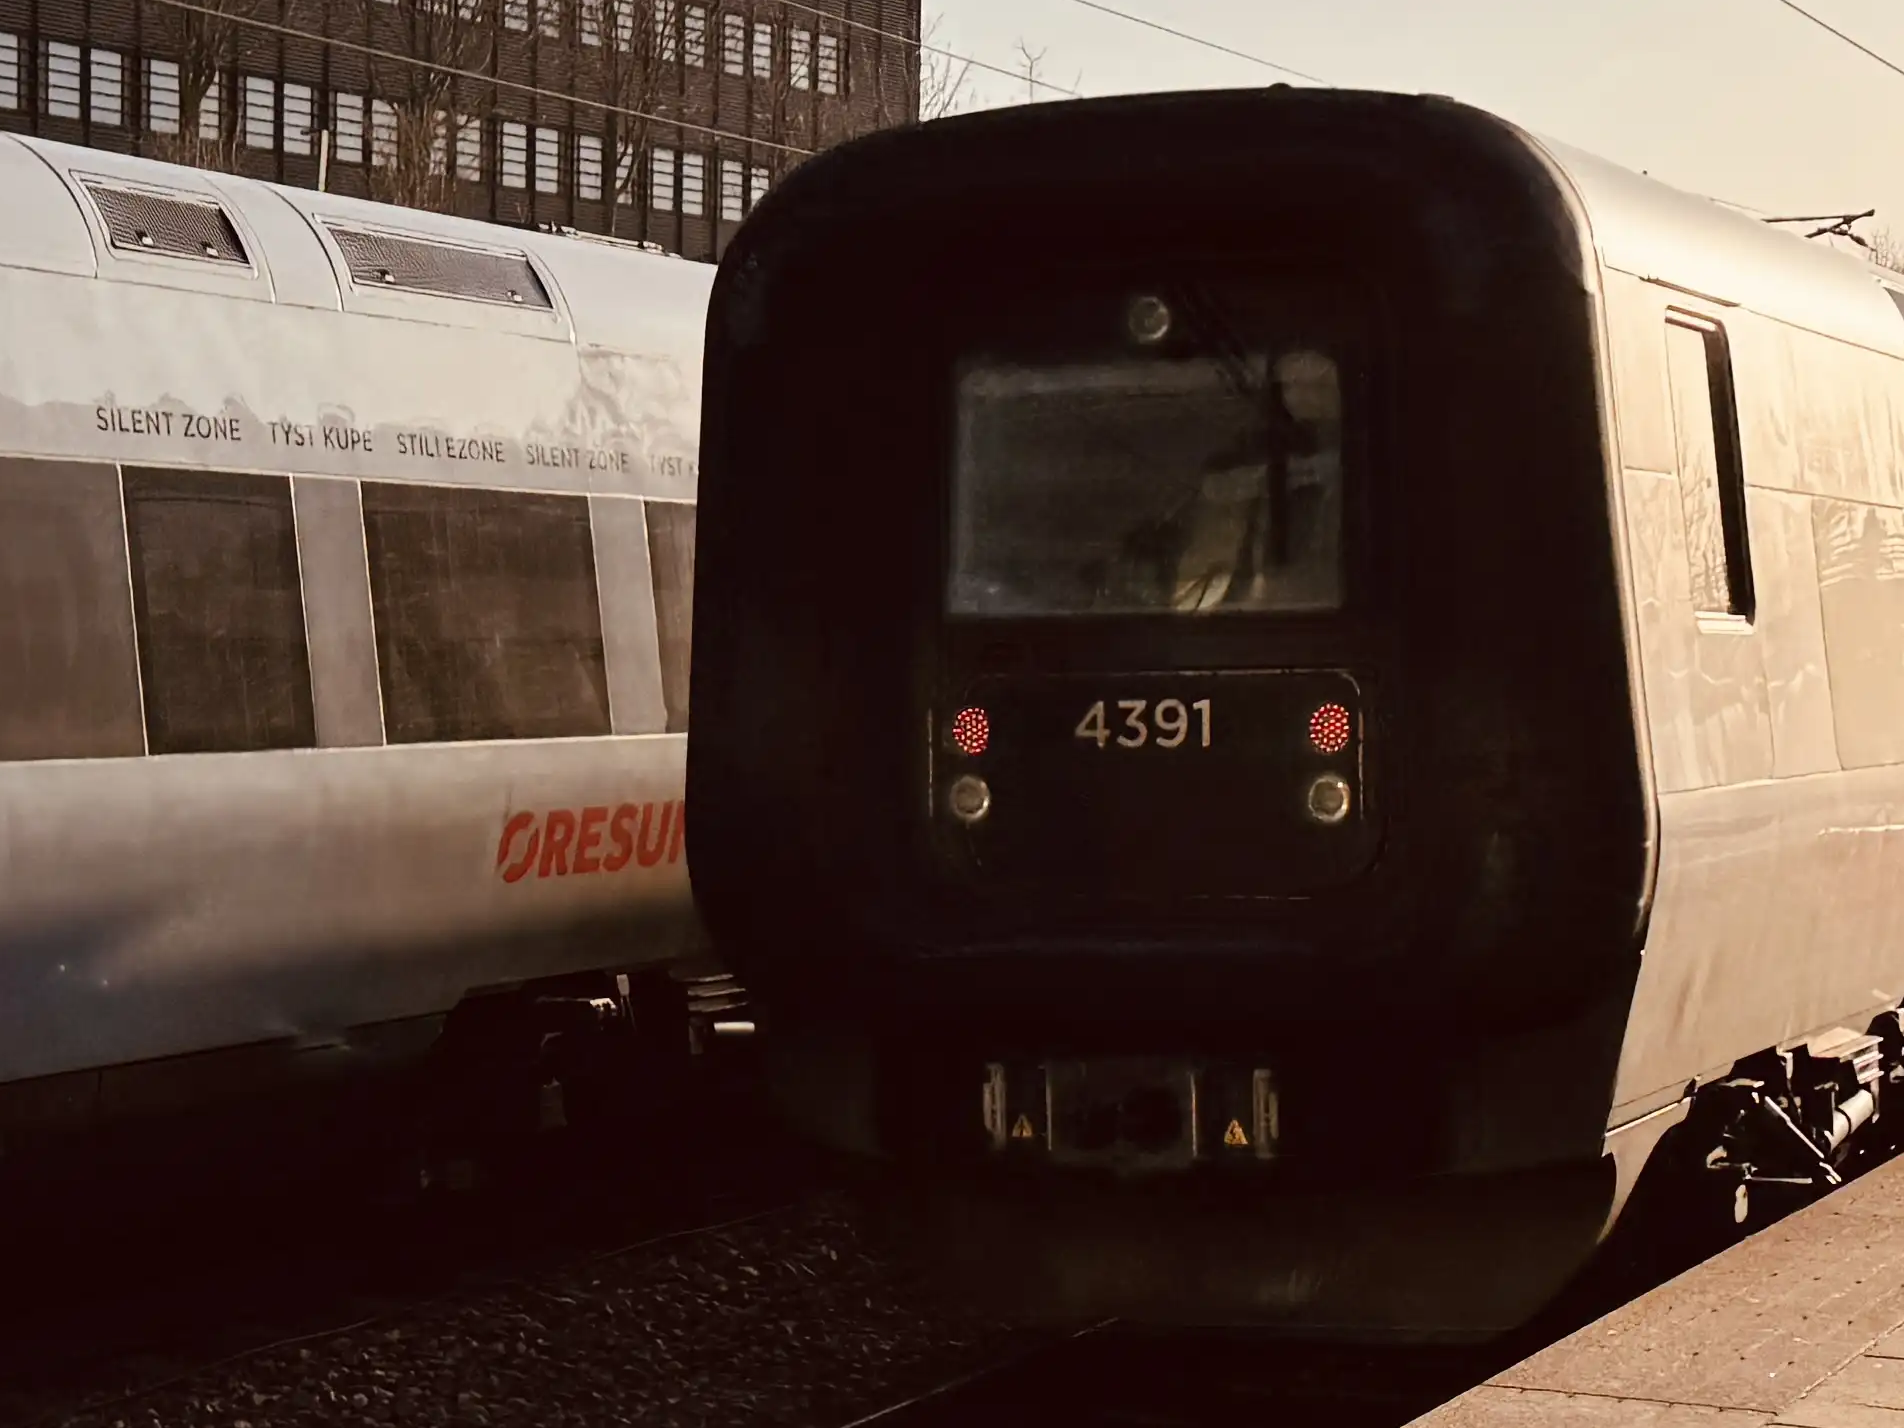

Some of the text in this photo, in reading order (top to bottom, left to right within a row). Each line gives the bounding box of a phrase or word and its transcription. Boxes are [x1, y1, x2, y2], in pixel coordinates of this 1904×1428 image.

[96, 405, 173, 436] SILENT
[182, 413, 243, 442] ZONE
[268, 421, 315, 448] TYST
[526, 443, 580, 470] SILENT
[587, 448, 632, 474] ZONE
[1074, 698, 1211, 749] 4391
